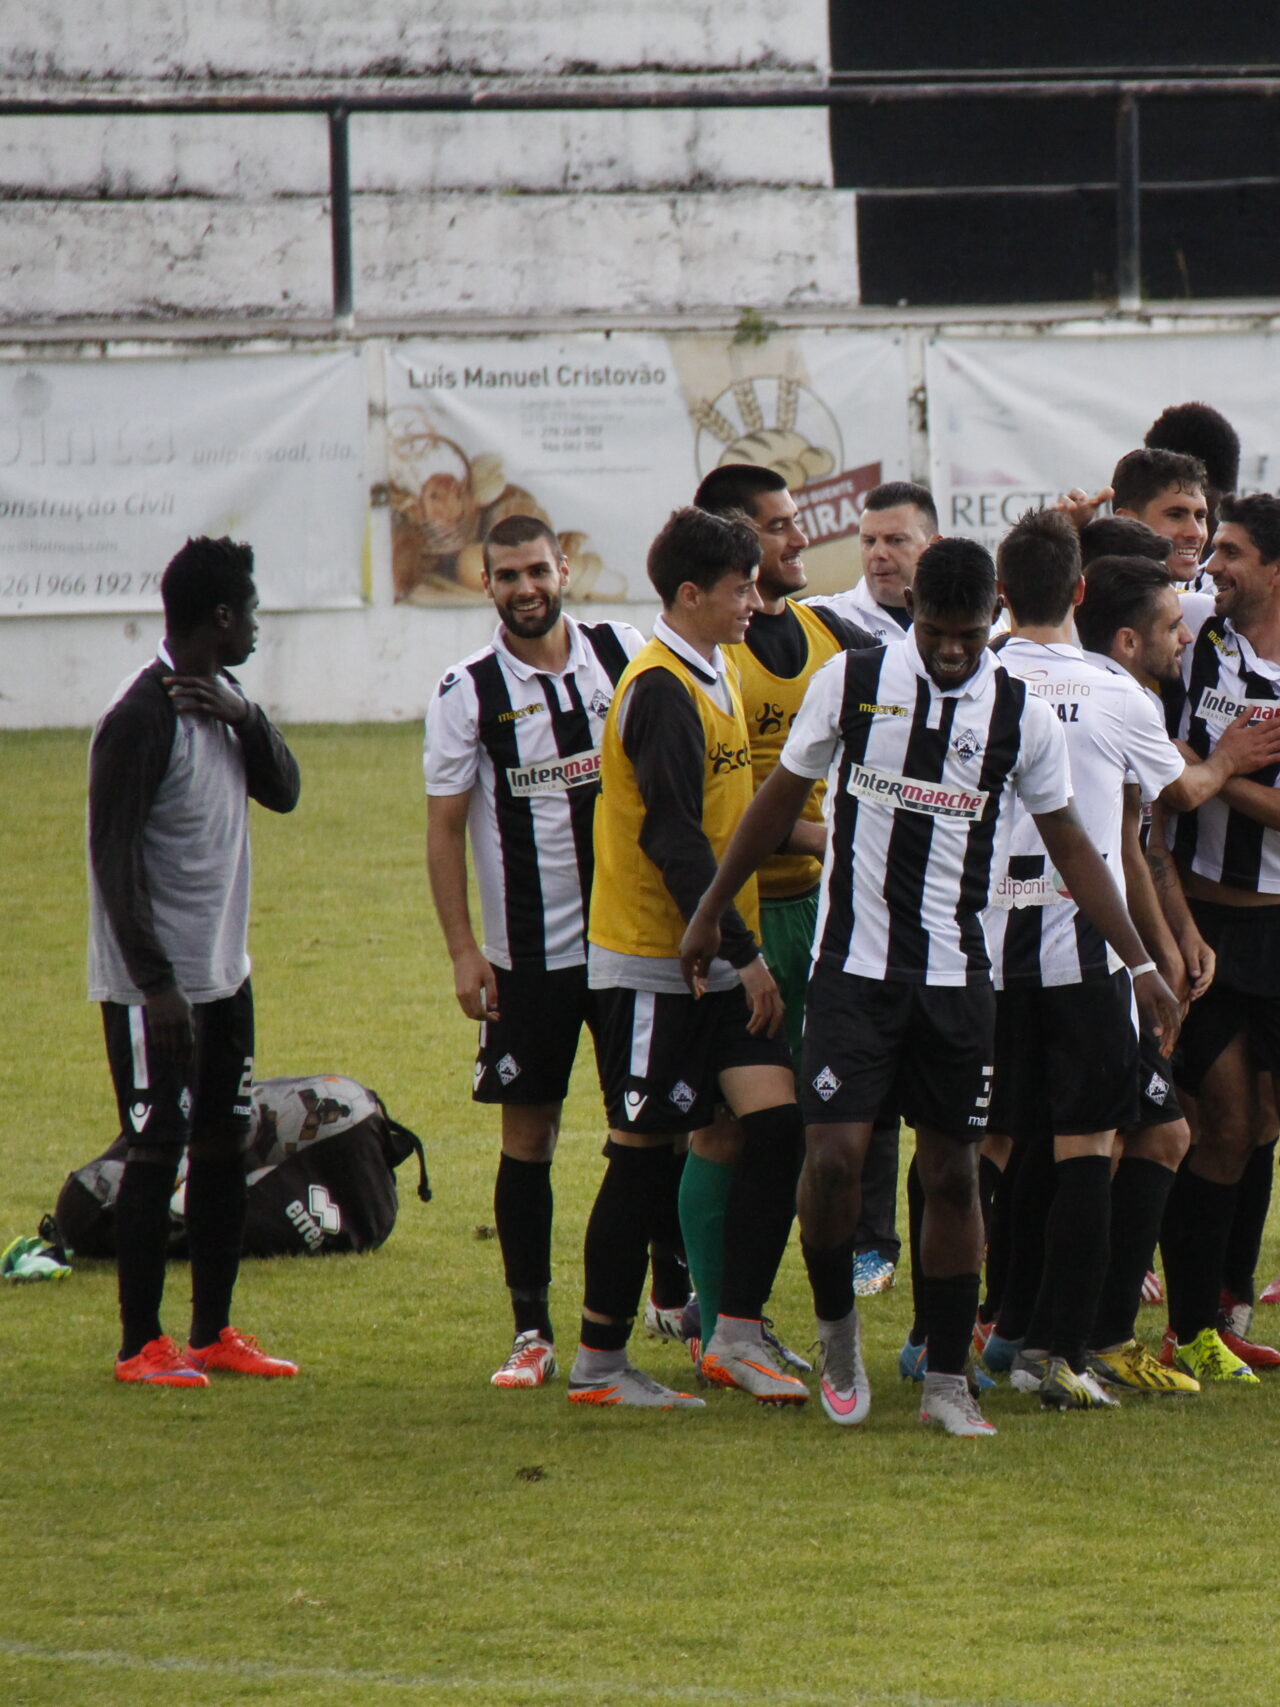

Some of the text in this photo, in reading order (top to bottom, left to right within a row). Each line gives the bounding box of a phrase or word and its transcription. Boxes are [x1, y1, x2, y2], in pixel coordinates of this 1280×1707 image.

[408, 363, 667, 389] Luís Manuel Cristovão
[124, 492, 175, 517] Civil
[951, 490, 1064, 529] RECT
[0, 574, 29, 598] 26
[1031, 679, 1091, 697] meiro
[1050, 702, 1079, 723] AZ
